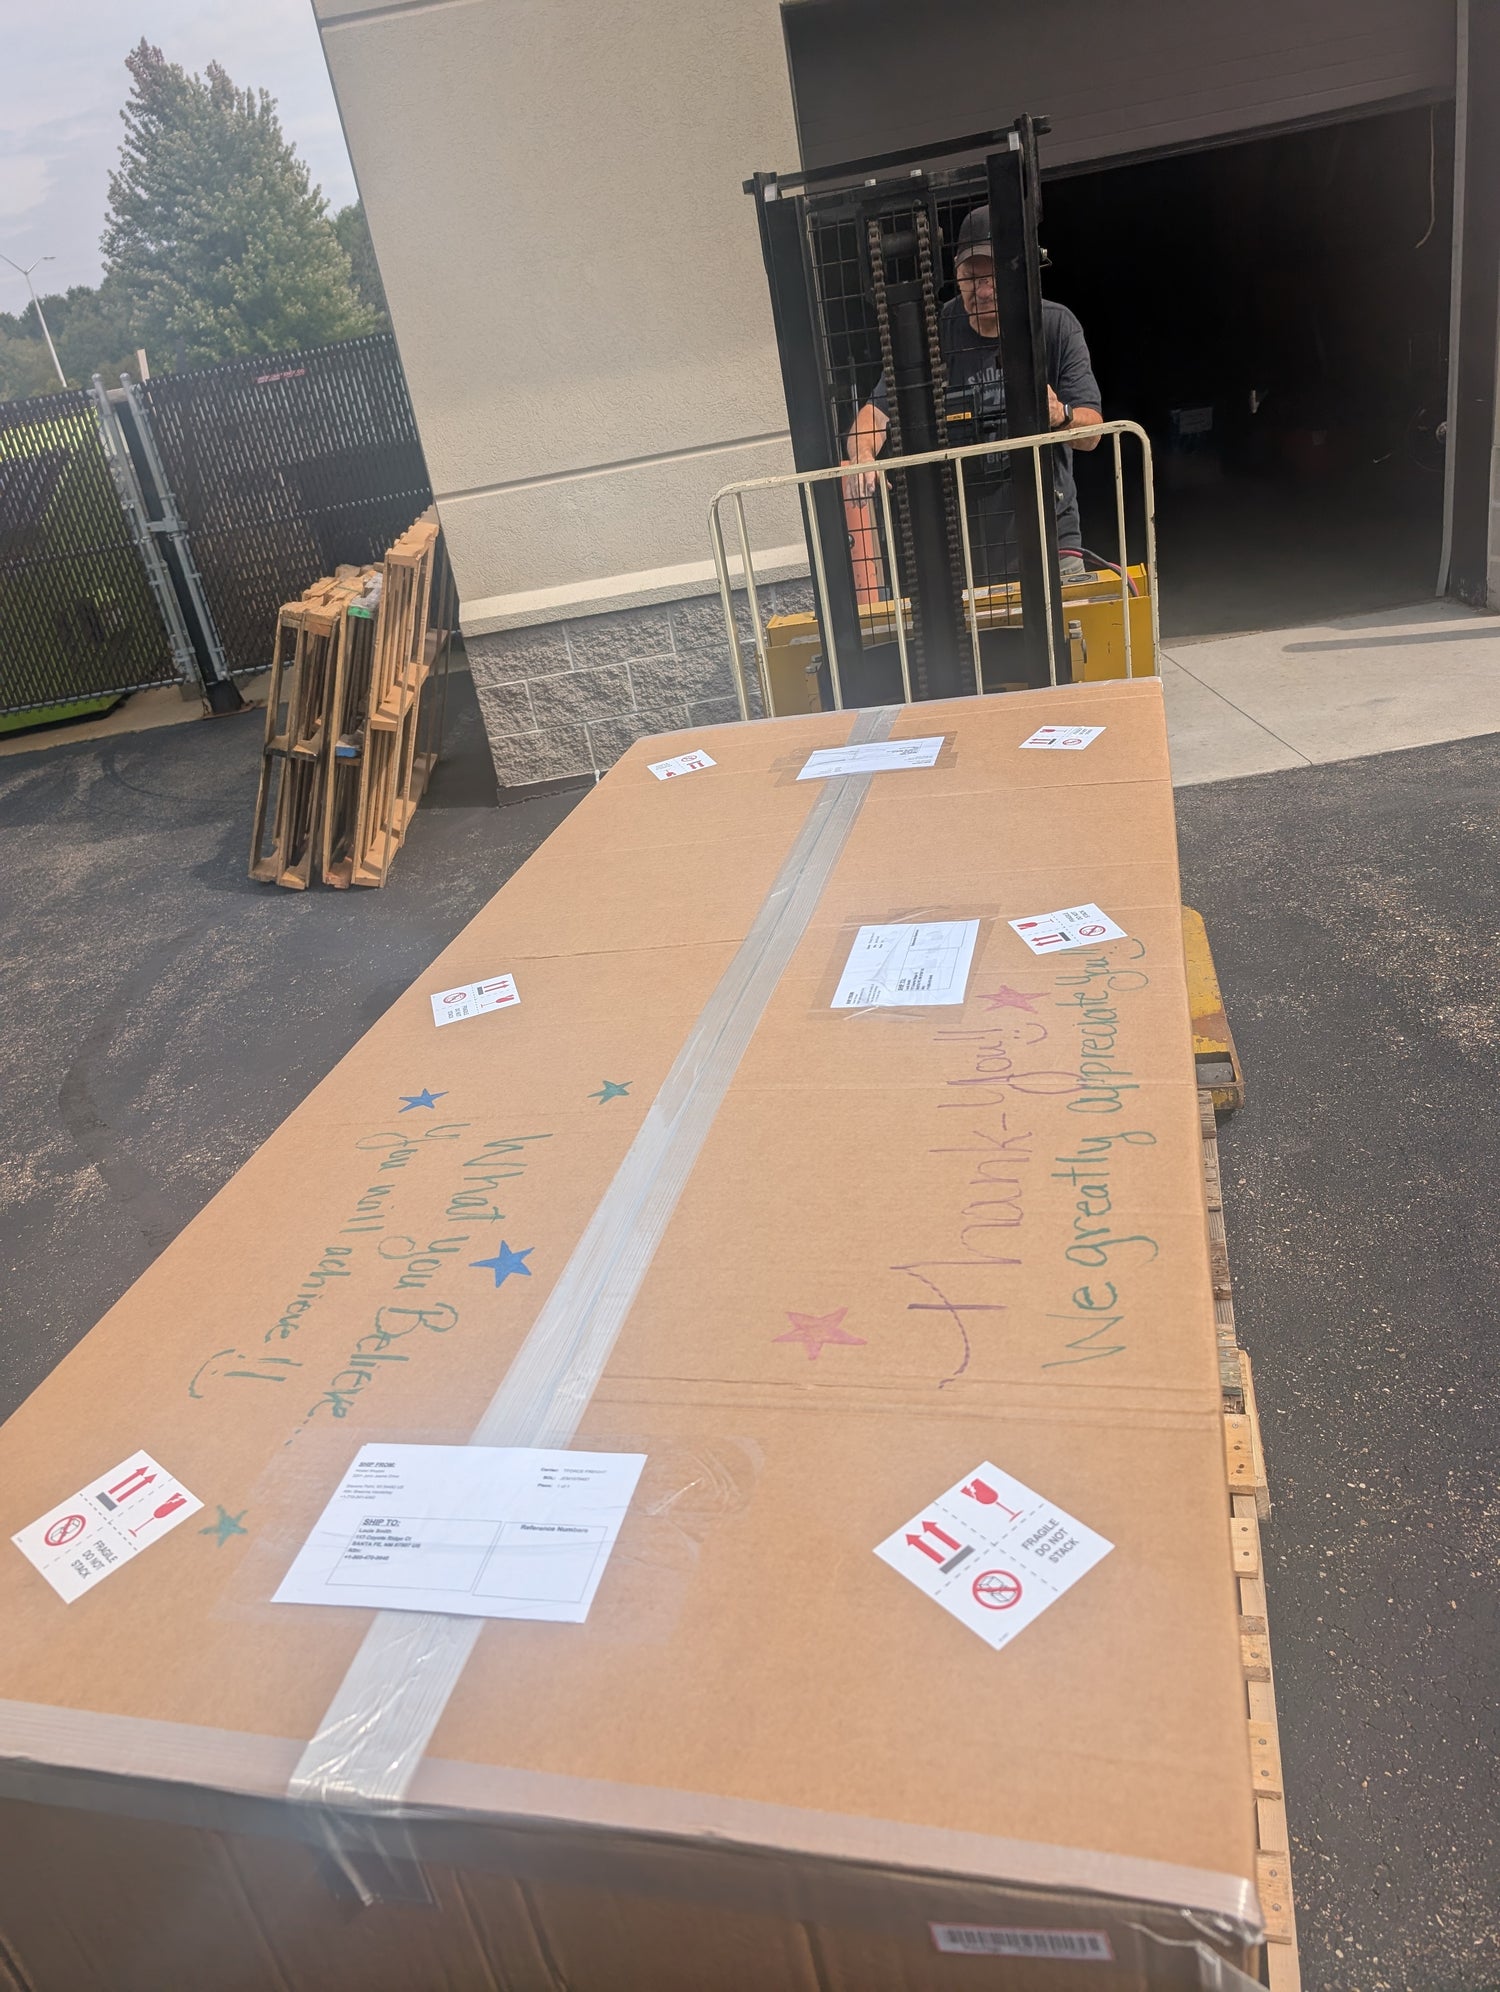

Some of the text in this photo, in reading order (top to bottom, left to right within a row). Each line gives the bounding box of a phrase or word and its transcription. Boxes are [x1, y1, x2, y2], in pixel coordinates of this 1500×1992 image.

[1054, 988, 1141, 1114] appreciate
[445, 1133, 554, 1223] What
[339, 1184, 395, 1234] will
[1051, 1130, 1159, 1269] greatly
[1042, 1280, 1126, 1368] We
[362, 1518, 401, 1528] SHIP TO:
[520, 1524, 588, 1534] Reference Numbers
[1021, 1518, 1060, 1550] FRAGILE
[93, 1540, 118, 1563] FRAGILE
[1035, 1528, 1069, 1558] DO NOT
[1048, 1538, 1080, 1564] STACK
[70, 1559, 91, 1579] STACK
[82, 1550, 105, 1571] DO NOT
